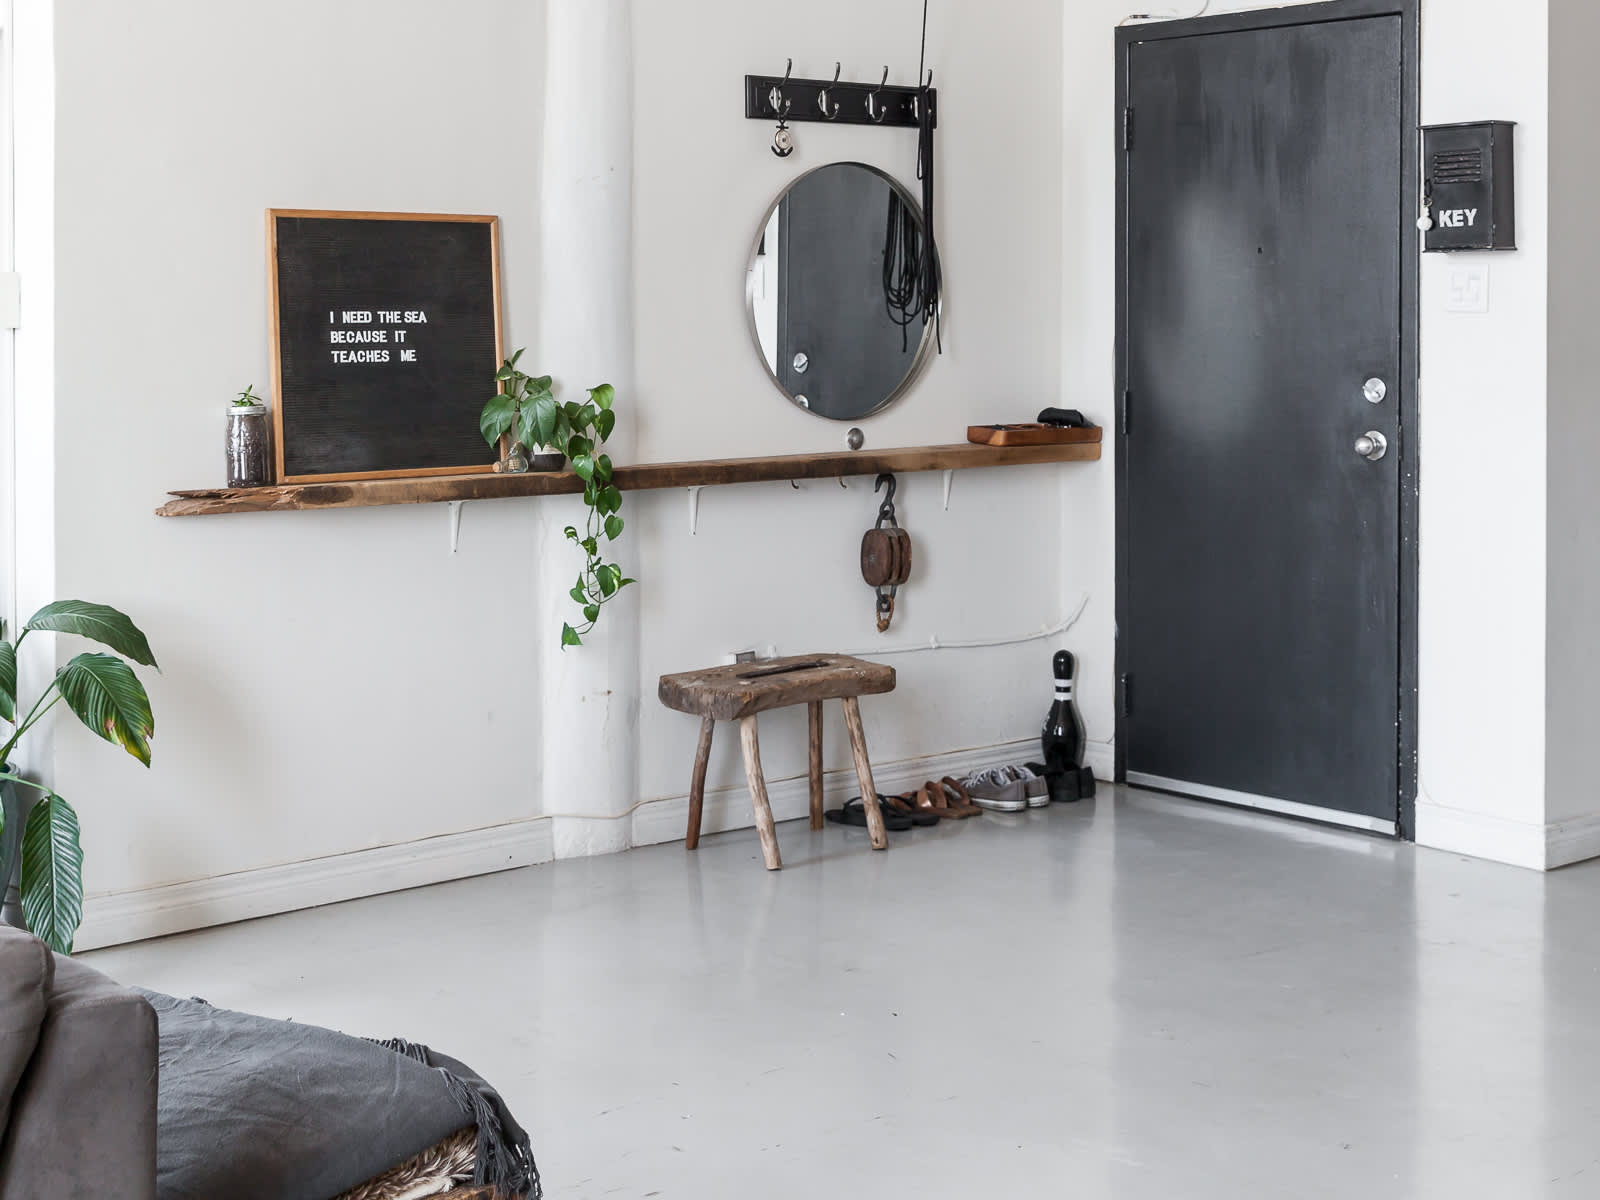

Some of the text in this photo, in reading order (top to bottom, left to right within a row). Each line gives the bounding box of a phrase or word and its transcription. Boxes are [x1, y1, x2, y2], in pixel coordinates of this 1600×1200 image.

[1438, 207, 1478, 228] KEY
[329, 310, 428, 324] I NEED THE SEA
[330, 330, 407, 344] BECAUSE IT
[330, 349, 417, 364] TEACHES ME
